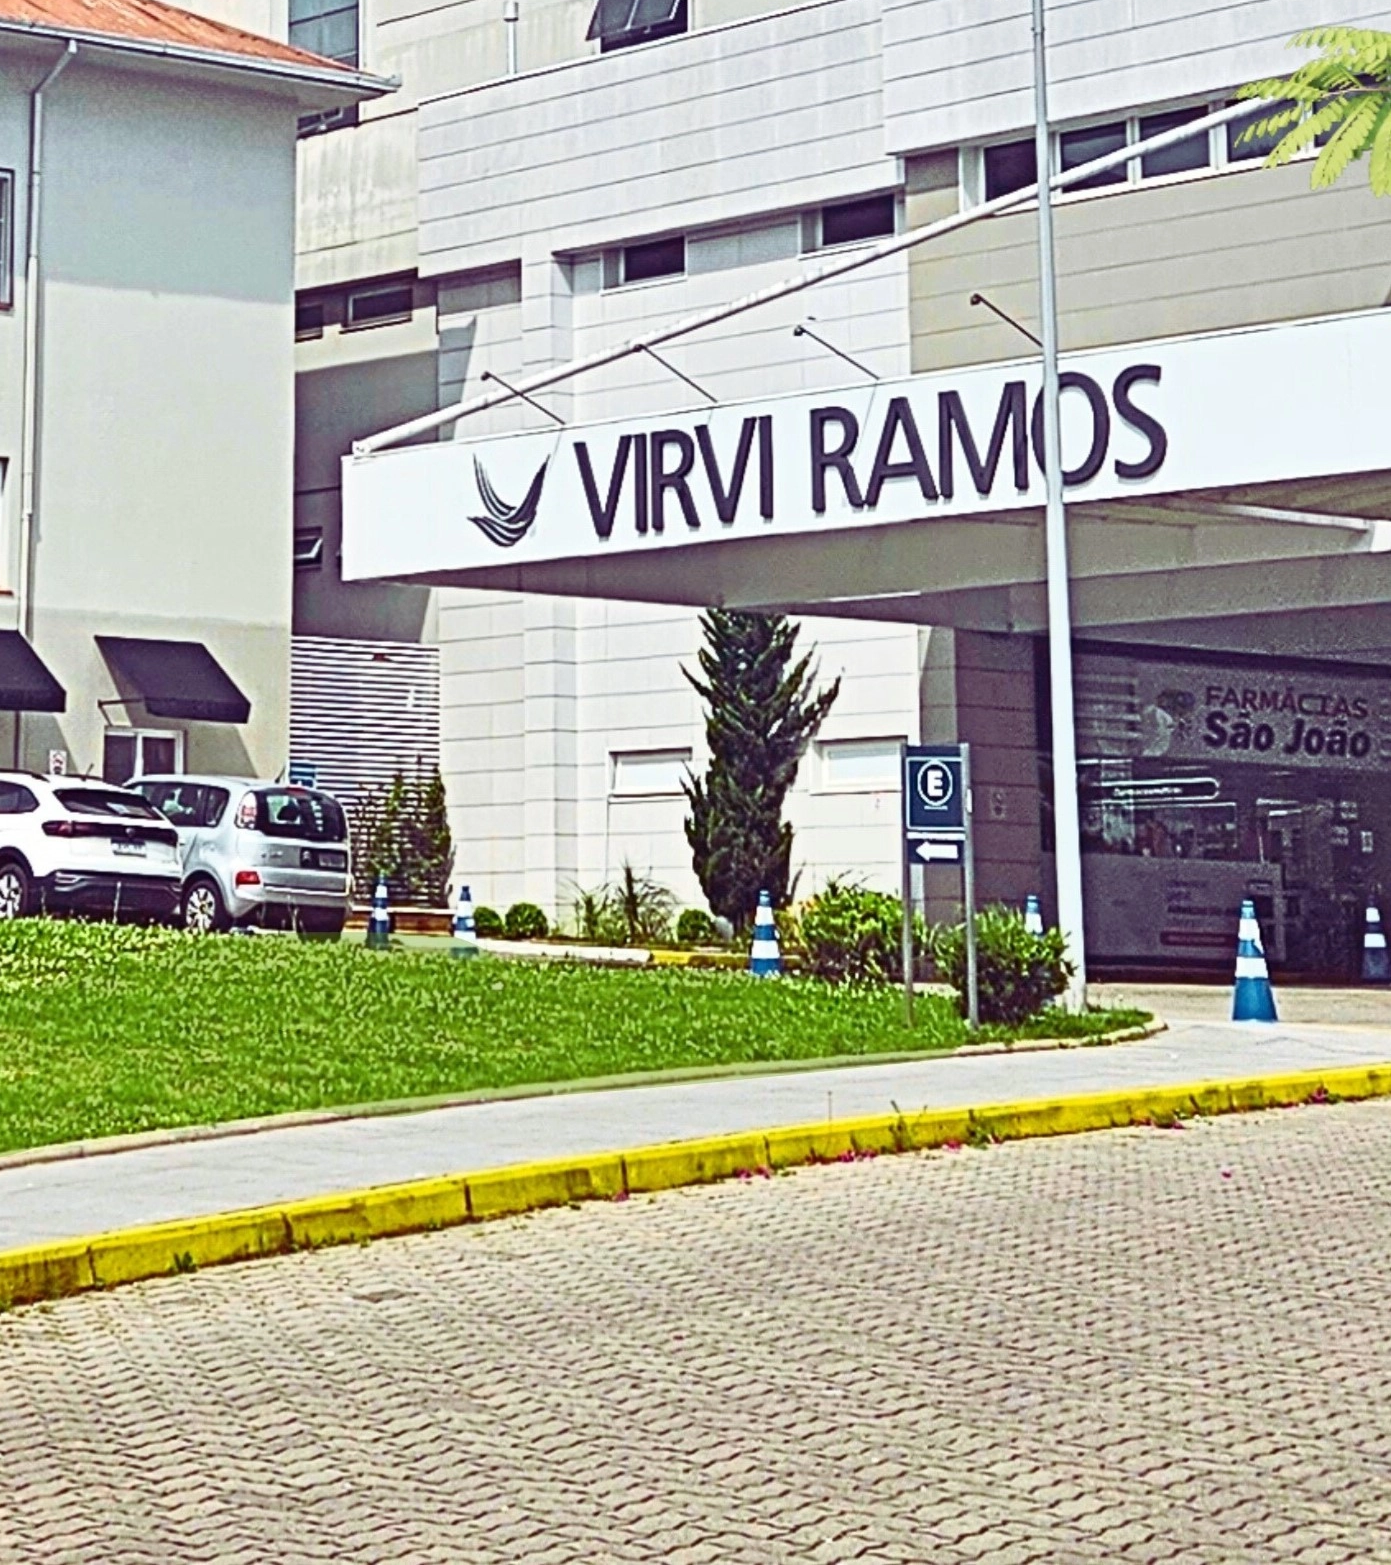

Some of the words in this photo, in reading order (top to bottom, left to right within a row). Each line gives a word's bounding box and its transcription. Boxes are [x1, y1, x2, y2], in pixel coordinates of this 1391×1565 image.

[574, 415, 774, 538] VIRVI
[811, 364, 1168, 513] RAMOS
[1205, 684, 1369, 719] FARMÁCIAS
[1203, 710, 1275, 752] São
[1283, 718, 1372, 758] João
[927, 769, 943, 797] E
